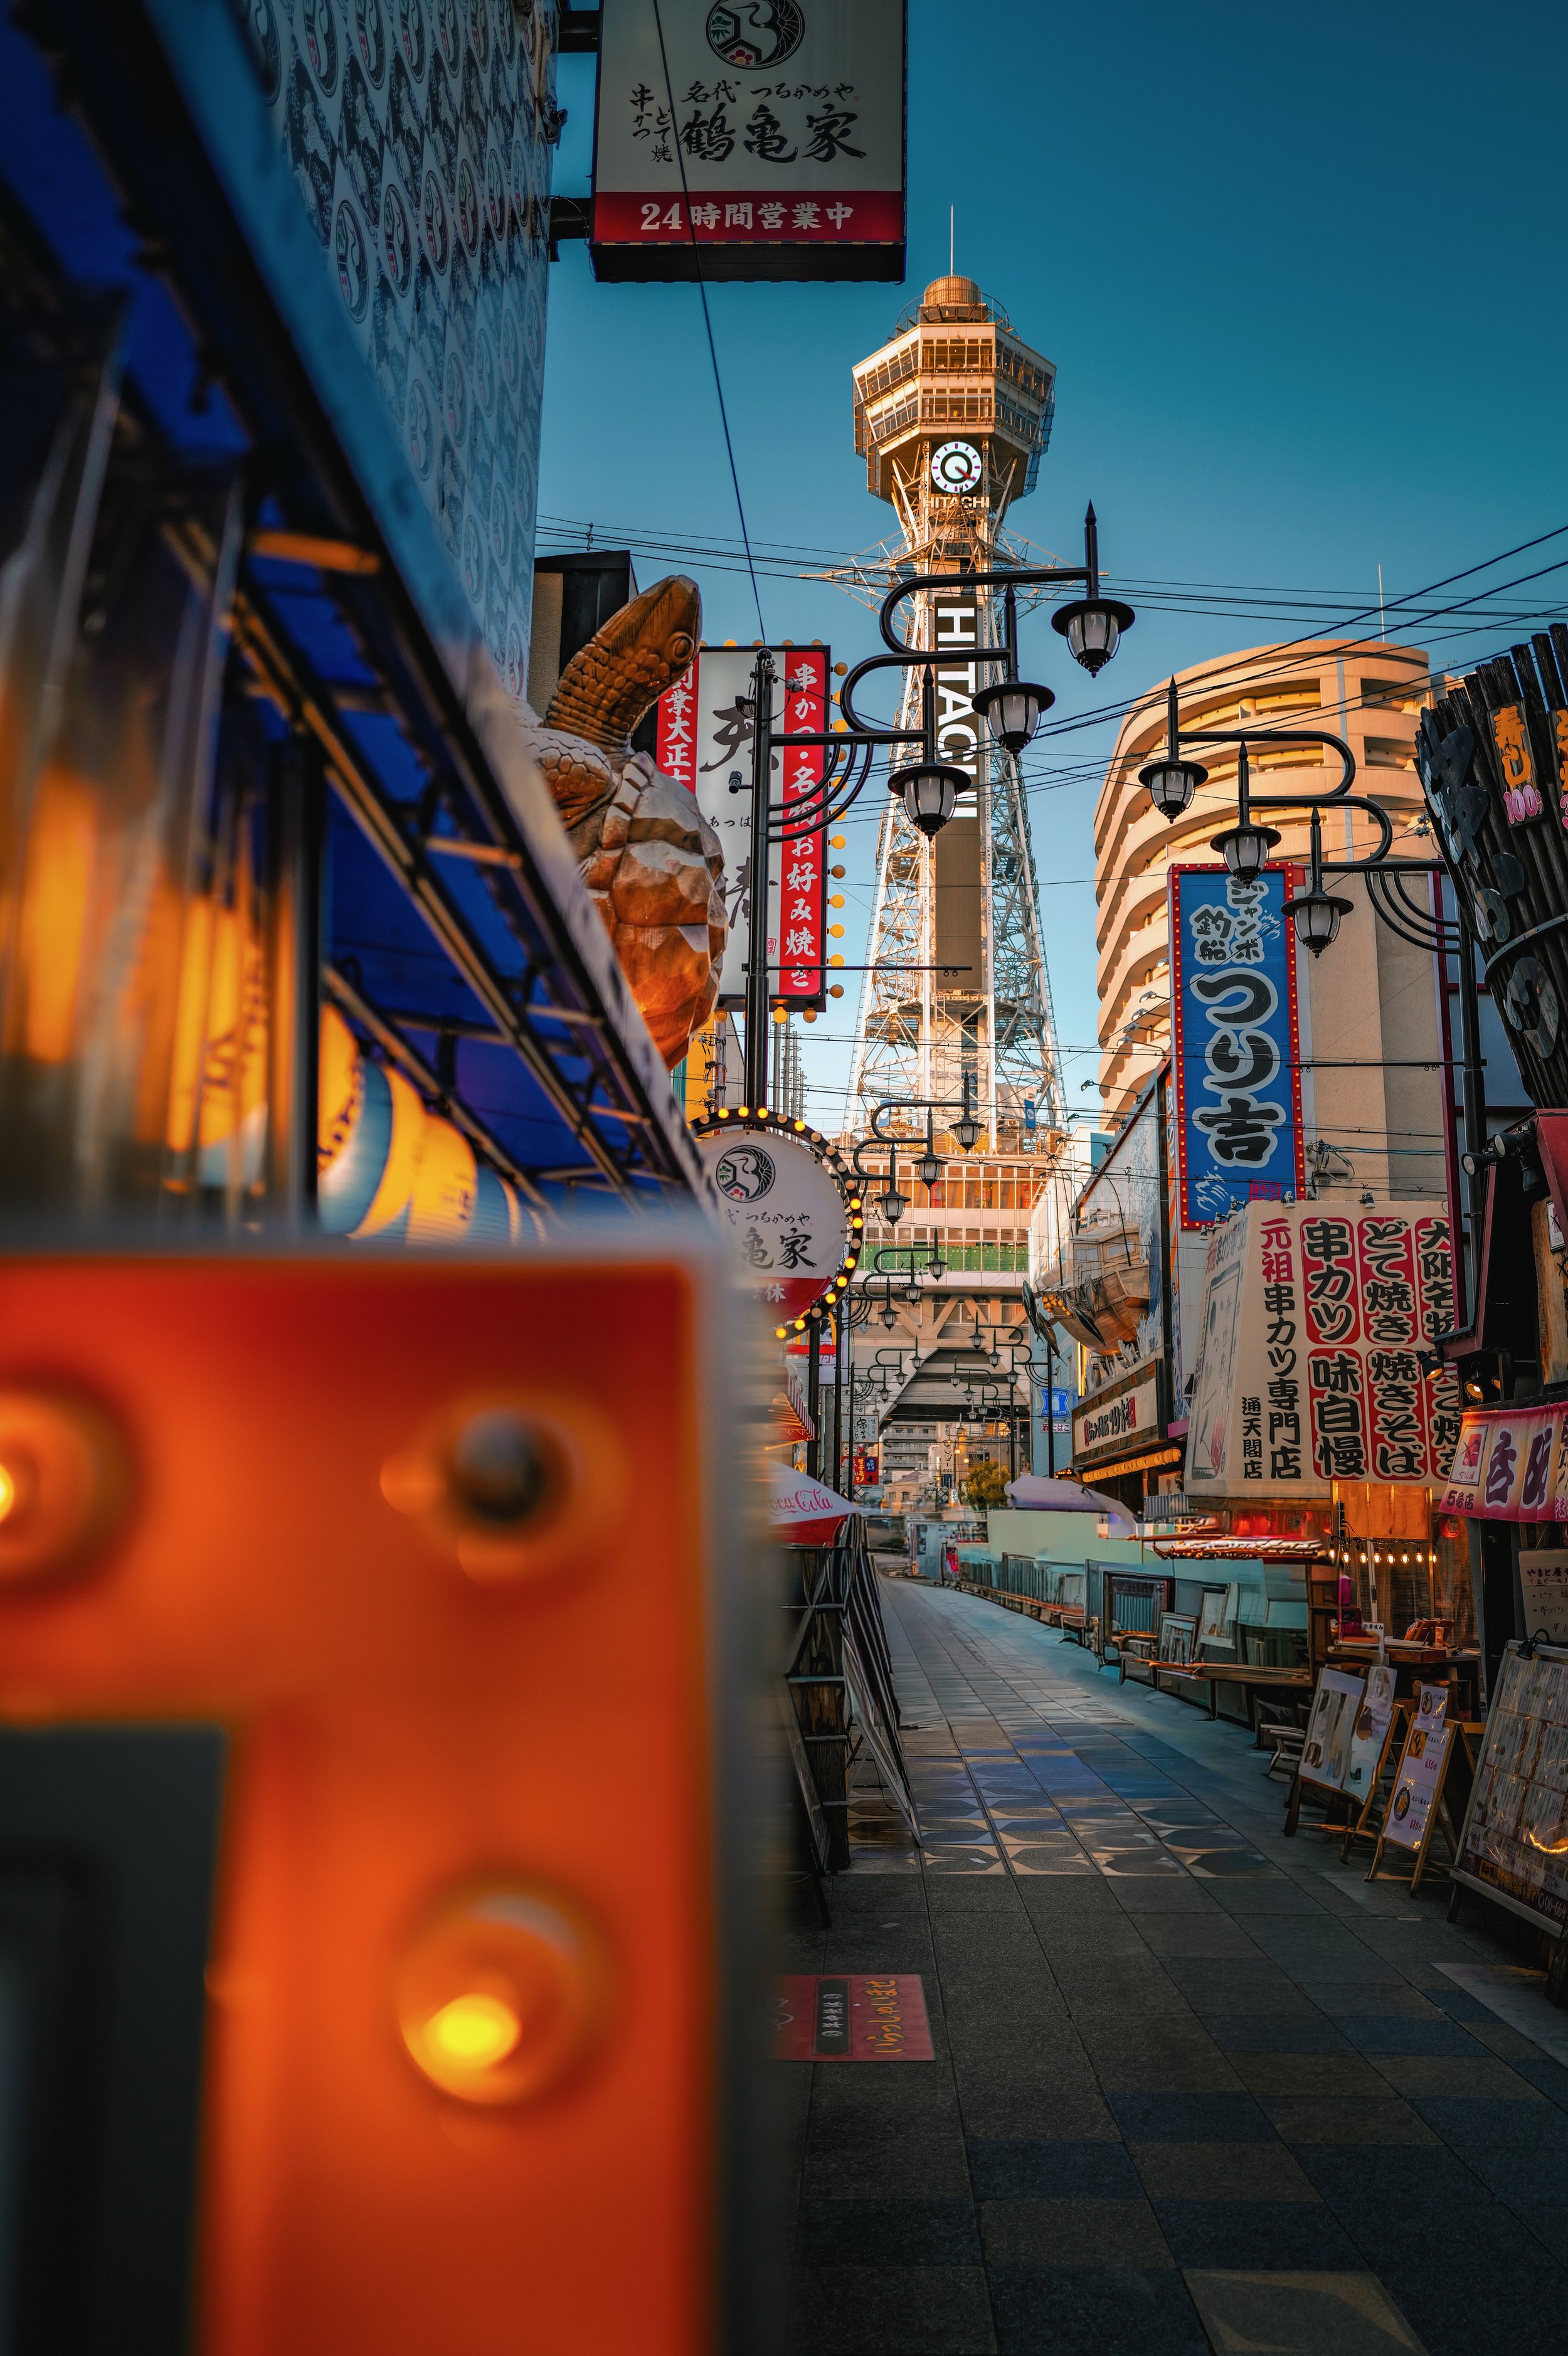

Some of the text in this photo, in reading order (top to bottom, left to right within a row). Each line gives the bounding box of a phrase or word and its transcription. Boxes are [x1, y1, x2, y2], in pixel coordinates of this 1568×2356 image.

[629, 83, 654, 141] 串かつ
[681, 80, 854, 103] 名代 つるかめや
[650, 105, 674, 163] どて焼
[679, 102, 867, 163] 鶴亀家
[640, 201, 854, 230] 24時間営業中
[923, 496, 990, 509] HITACHI
[937, 607, 977, 818] HTACHI
[1491, 706, 1531, 786] 寿し
[1197, 973, 1279, 1162] つり吉
[745, 1212, 810, 1226] つるかめや
[1306, 1221, 1353, 1340] 串カツ
[1365, 1221, 1414, 1341] どて焼き
[1261, 1218, 1302, 1480] 元祖串カツ専門店
[1242, 1397, 1263, 1480] 通天閣店
[1312, 1354, 1362, 1475] 味自慢
[1372, 1352, 1424, 1475] 焼きそば
[769, 1488, 833, 1512] oca-Cola
[1446, 1490, 1474, 1510] 5号店
[1424, 1758, 1437, 1771] 650円
[864, 1979, 905, 2054] いらっしゃいませ
